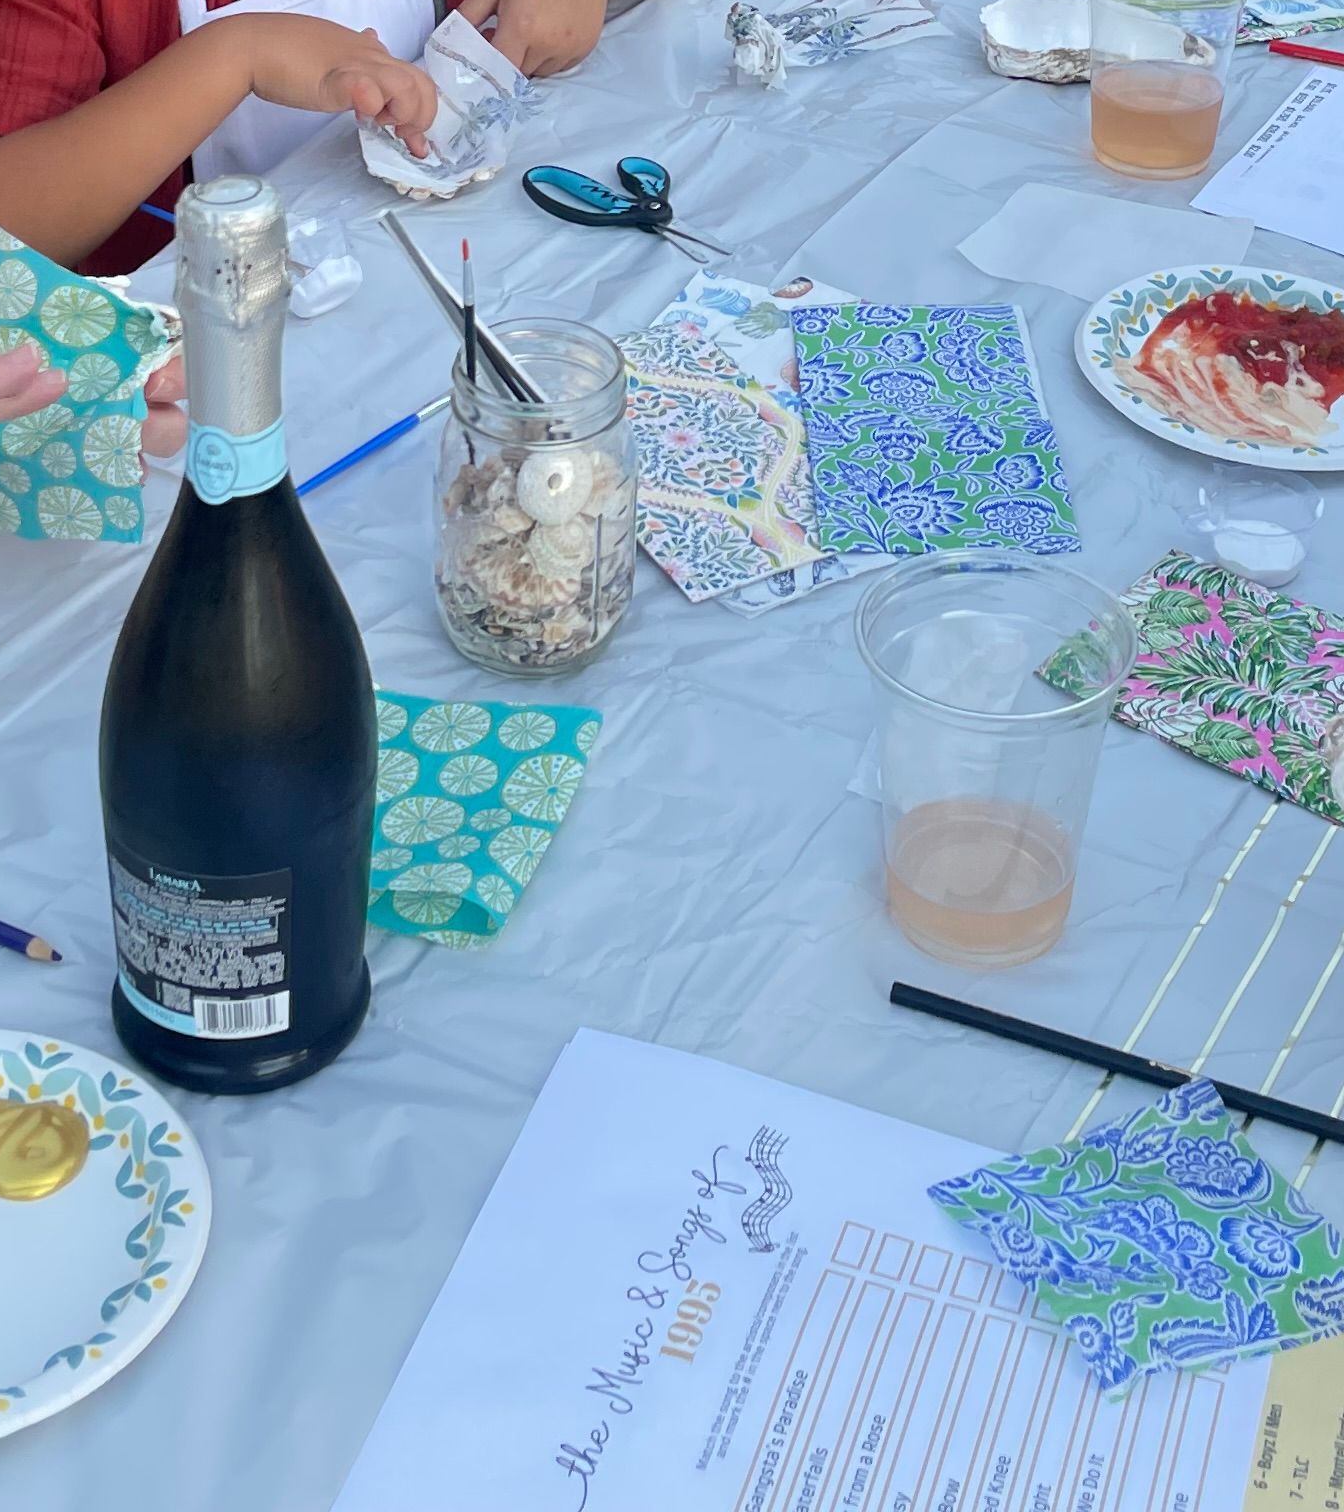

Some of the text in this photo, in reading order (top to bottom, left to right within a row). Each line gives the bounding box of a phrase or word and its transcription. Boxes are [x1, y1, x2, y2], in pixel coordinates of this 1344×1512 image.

[555, 1145, 747, 1511] the Music & Songs of
[659, 1278, 721, 1363] 1995
[710, 1413, 725, 1433] the
[719, 1385, 738, 1413] song
[733, 1352, 748, 1371] the
[716, 1435, 731, 1459] and
[734, 1385, 749, 1404] the
[750, 1344, 765, 1363] the
[759, 1314, 776, 1345] space
[772, 1369, 808, 1434] Paradise
[1264, 1403, 1282, 1429] Men
[842, 1414, 886, 1506] from a Rose
[1087, 1453, 1104, 1467] It
[1256, 1438, 1277, 1470] Boyz
[1292, 1455, 1309, 1479] TLC
[795, 1447, 828, 1512] aterfalls
[987, 1455, 1011, 1494] Knee
[1081, 1468, 1101, 1490] Do
[1252, 1479, 1268, 1489] 6
[937, 1478, 960, 1512] Bow
[1288, 1489, 1303, 1499] 7
[1324, 1499, 1339, 1510] 8
